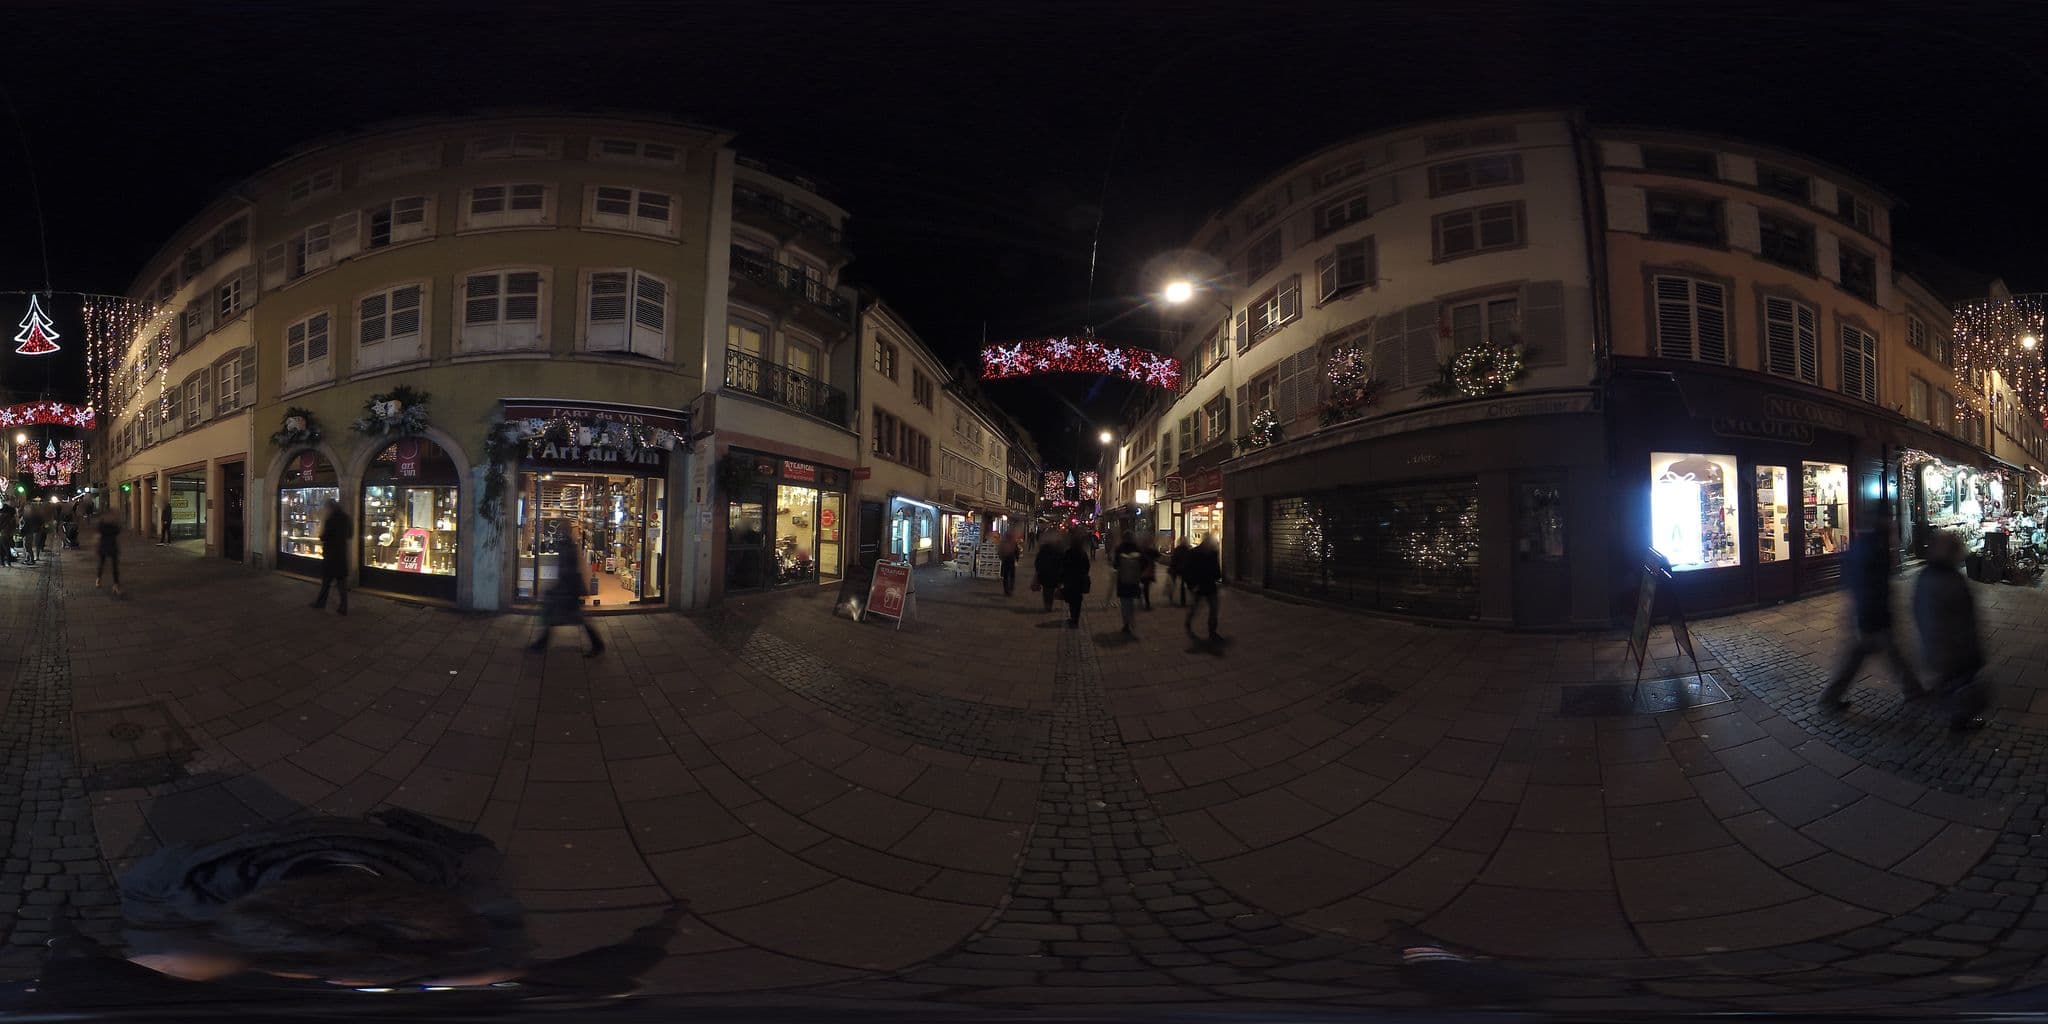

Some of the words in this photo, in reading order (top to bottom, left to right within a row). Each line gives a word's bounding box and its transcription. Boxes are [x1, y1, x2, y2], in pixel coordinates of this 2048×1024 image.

[596, 411, 613, 420] du
[617, 413, 644, 424] VIN
[1770, 399, 1842, 425] NICOLAS
[1719, 416, 1809, 440] NICOLAS
[588, 446, 617, 462] du
[624, 447, 660, 465] Vin
